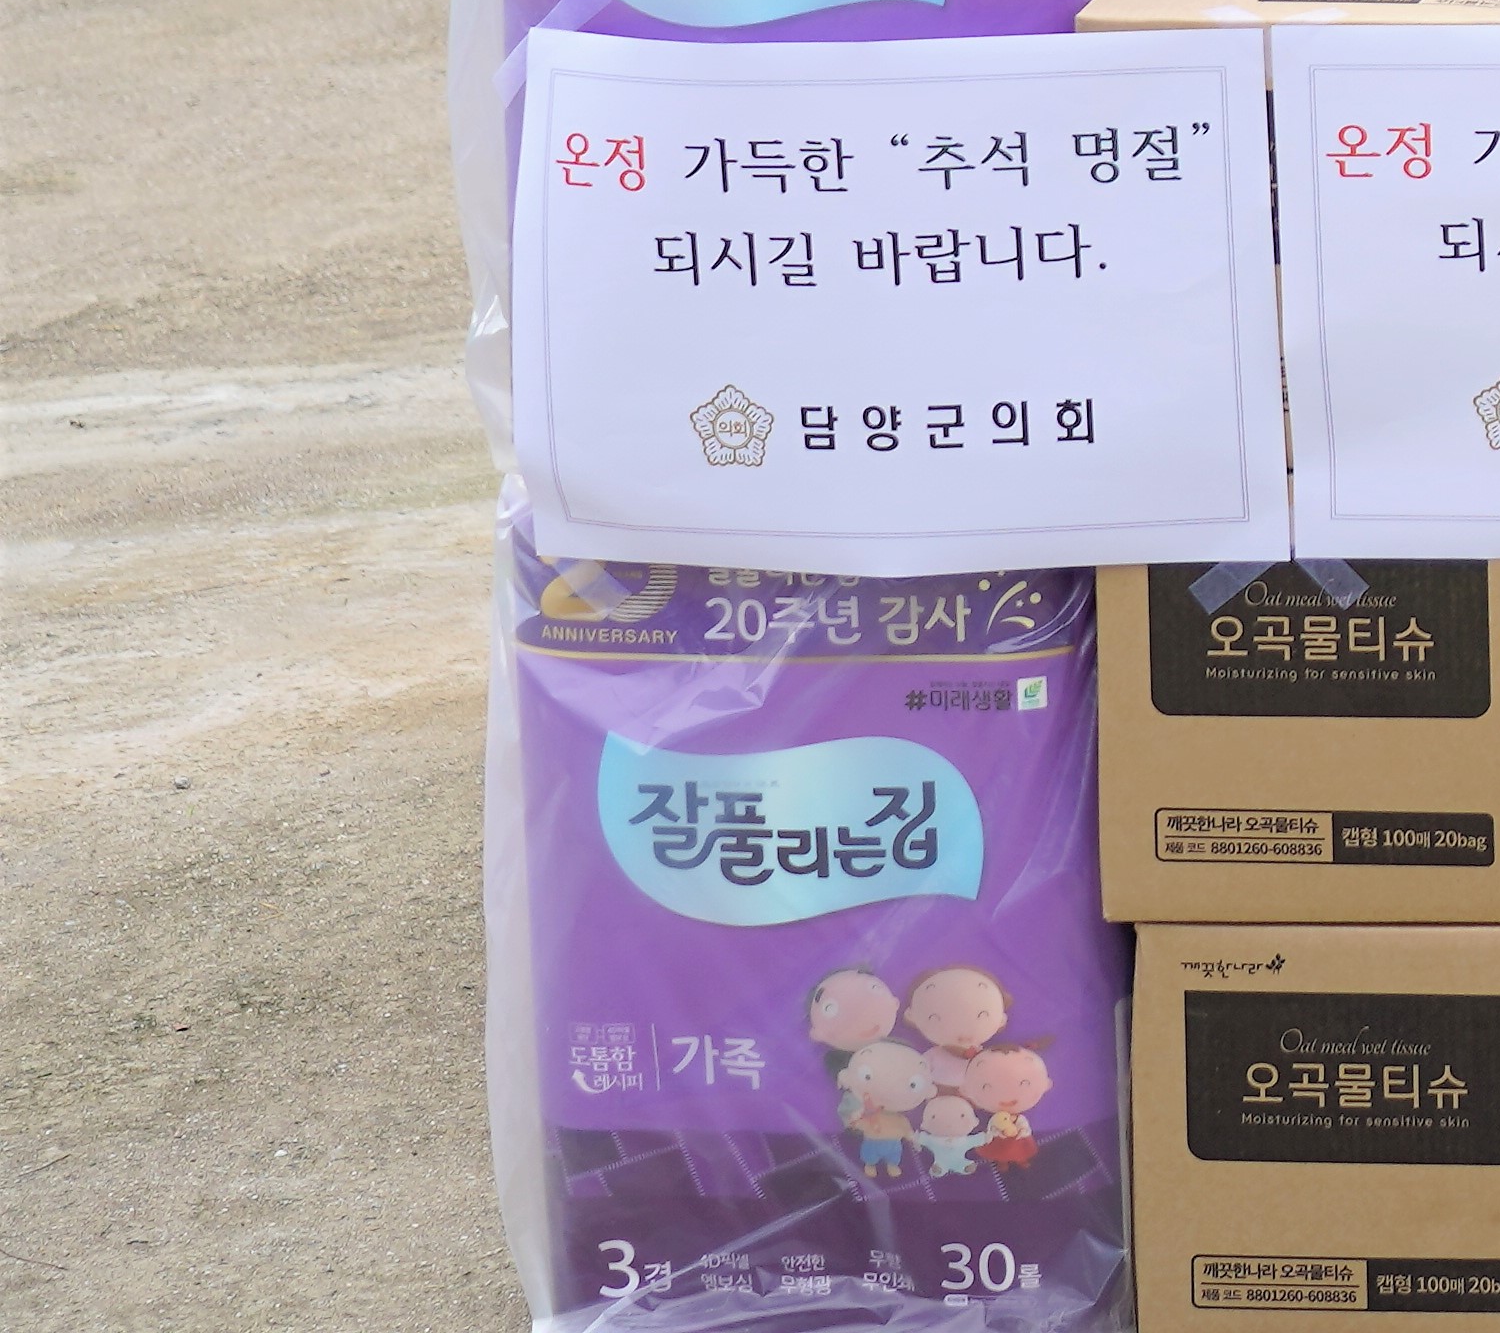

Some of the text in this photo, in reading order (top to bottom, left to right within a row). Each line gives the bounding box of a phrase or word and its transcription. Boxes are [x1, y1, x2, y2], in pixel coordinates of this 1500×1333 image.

[556, 133, 645, 191] 온정
[685, 138, 853, 193] 가득한
[1326, 123, 1431, 179] 온정
[655, 224, 1106, 286] 되시길 바랍니다.
[541, 624, 679, 645] ANNIVERSARY
[704, 592, 970, 649] 20주년 감사
[1207, 615, 1435, 661] 오곡물티슈
[627, 779, 939, 886] 잘풀리는집
[1166, 813, 1319, 834] 깨끗한나라 오곡물티슈
[1342, 827, 1487, 851] 캡형 100매 20bag
[1210, 840, 1323, 857] 8801260-608836
[672, 1035, 765, 1090] 가족
[1243, 1063, 1467, 1109] 오곡물티슈
[1242, 1113, 1470, 1128] Moisturizing for sensitive skin
[1203, 1262, 1354, 1282] 깨끗한나라 오곡물티슈
